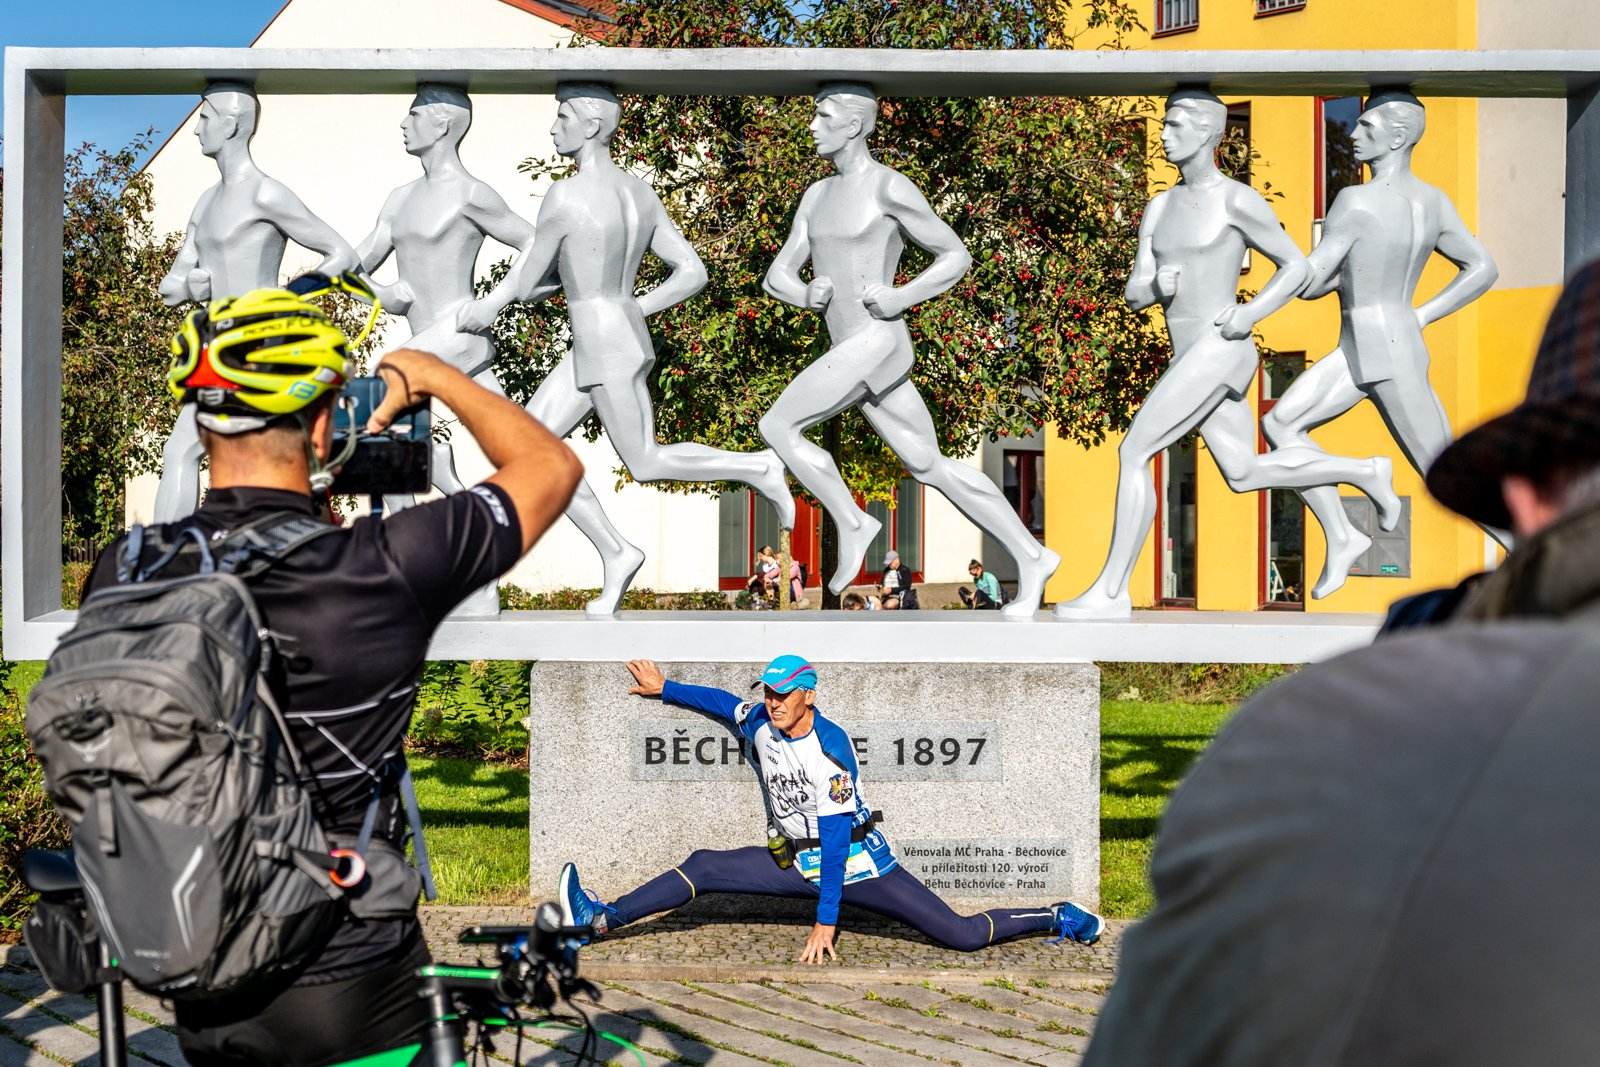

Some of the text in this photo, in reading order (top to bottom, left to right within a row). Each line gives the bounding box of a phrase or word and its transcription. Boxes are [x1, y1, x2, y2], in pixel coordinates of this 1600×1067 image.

[645, 729, 987, 766] BĚCHE 1897
[904, 846, 951, 858] Věnovala
[954, 844, 971, 857] MČ
[975, 846, 1004, 858] Praha
[1015, 846, 1067, 858] Běchovice
[922, 861, 1049, 875] u příležitosti 120. výročí
[924, 879, 951, 889] Běhu
[954, 878, 1006, 889] Běchovice
[1017, 879, 1046, 889] Praha
